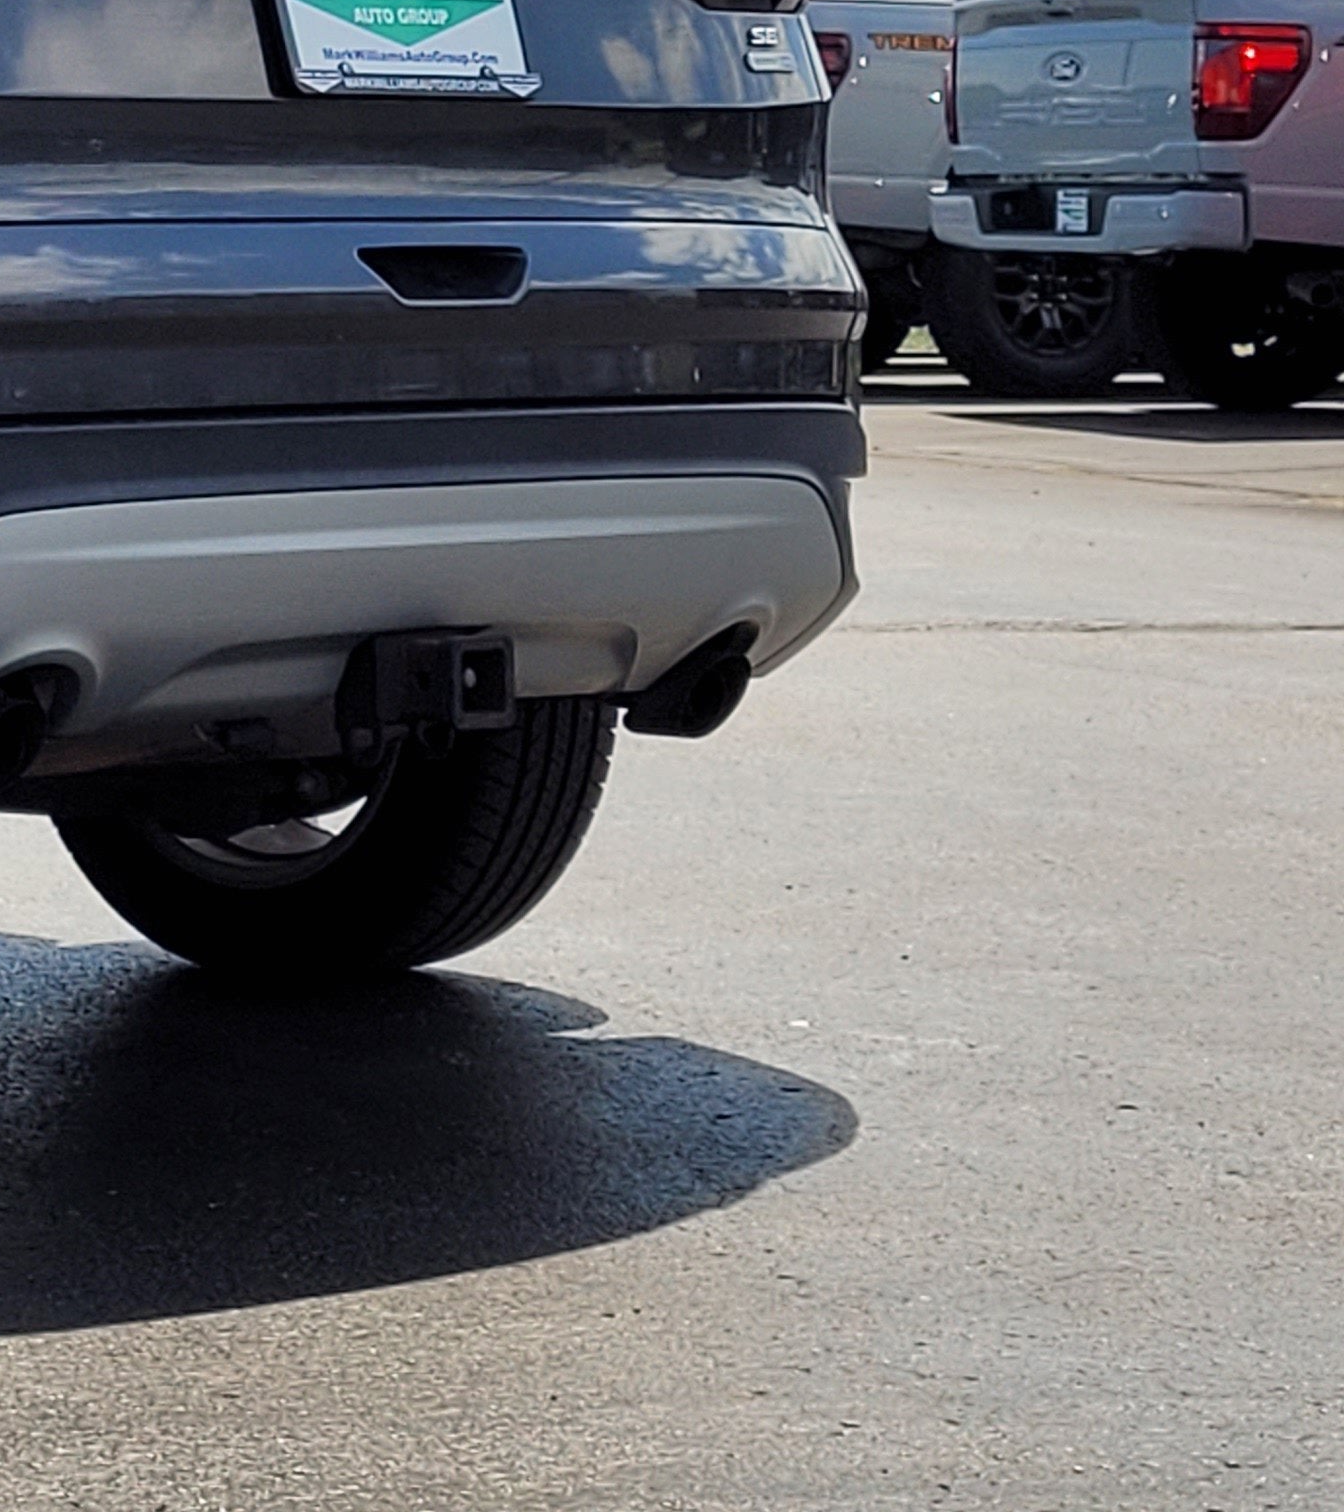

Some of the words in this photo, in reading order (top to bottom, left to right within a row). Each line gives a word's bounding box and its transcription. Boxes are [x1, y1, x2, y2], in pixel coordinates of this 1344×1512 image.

[354, 7, 394, 24] AUTO
[398, 8, 448, 26] GROUP
[750, 27, 779, 45] SE
